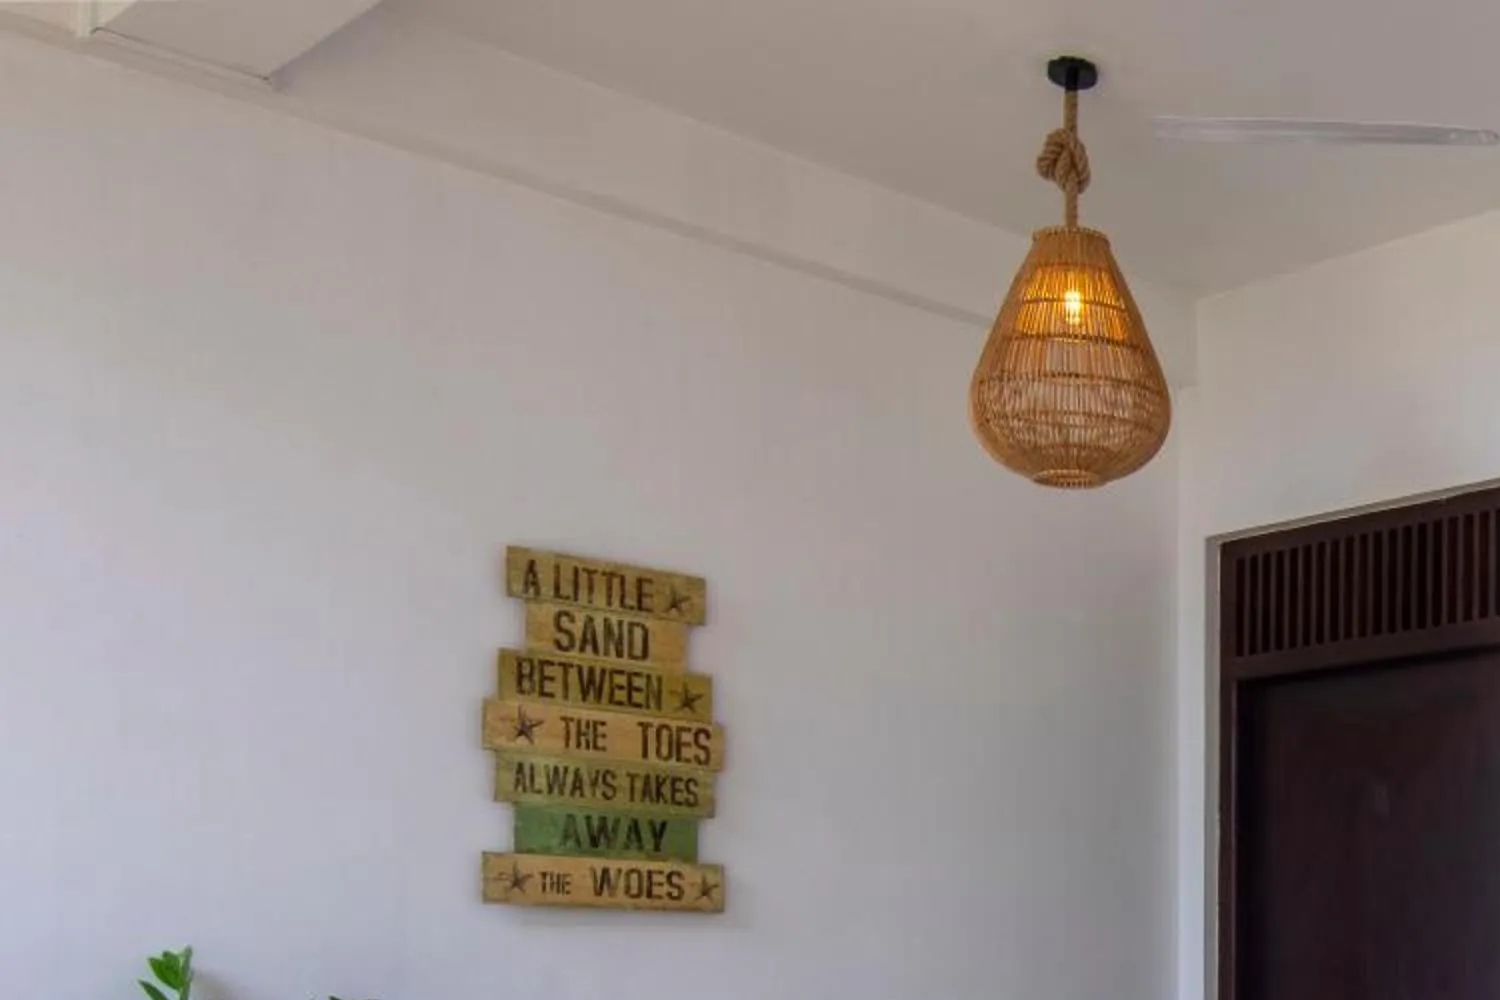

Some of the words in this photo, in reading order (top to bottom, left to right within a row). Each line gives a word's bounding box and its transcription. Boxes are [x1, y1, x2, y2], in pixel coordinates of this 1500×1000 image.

[521, 559, 541, 597] A
[553, 564, 654, 613] LITTLE
[553, 609, 650, 662] SAND
[515, 655, 663, 712] BETWEEN
[560, 714, 607, 752] THE
[637, 720, 712, 767] TOES
[514, 761, 617, 801] ALWAYS
[626, 771, 700, 809] TAKES
[560, 812, 669, 853] AWAY
[540, 870, 572, 896] THE
[589, 864, 685, 902] WOES
